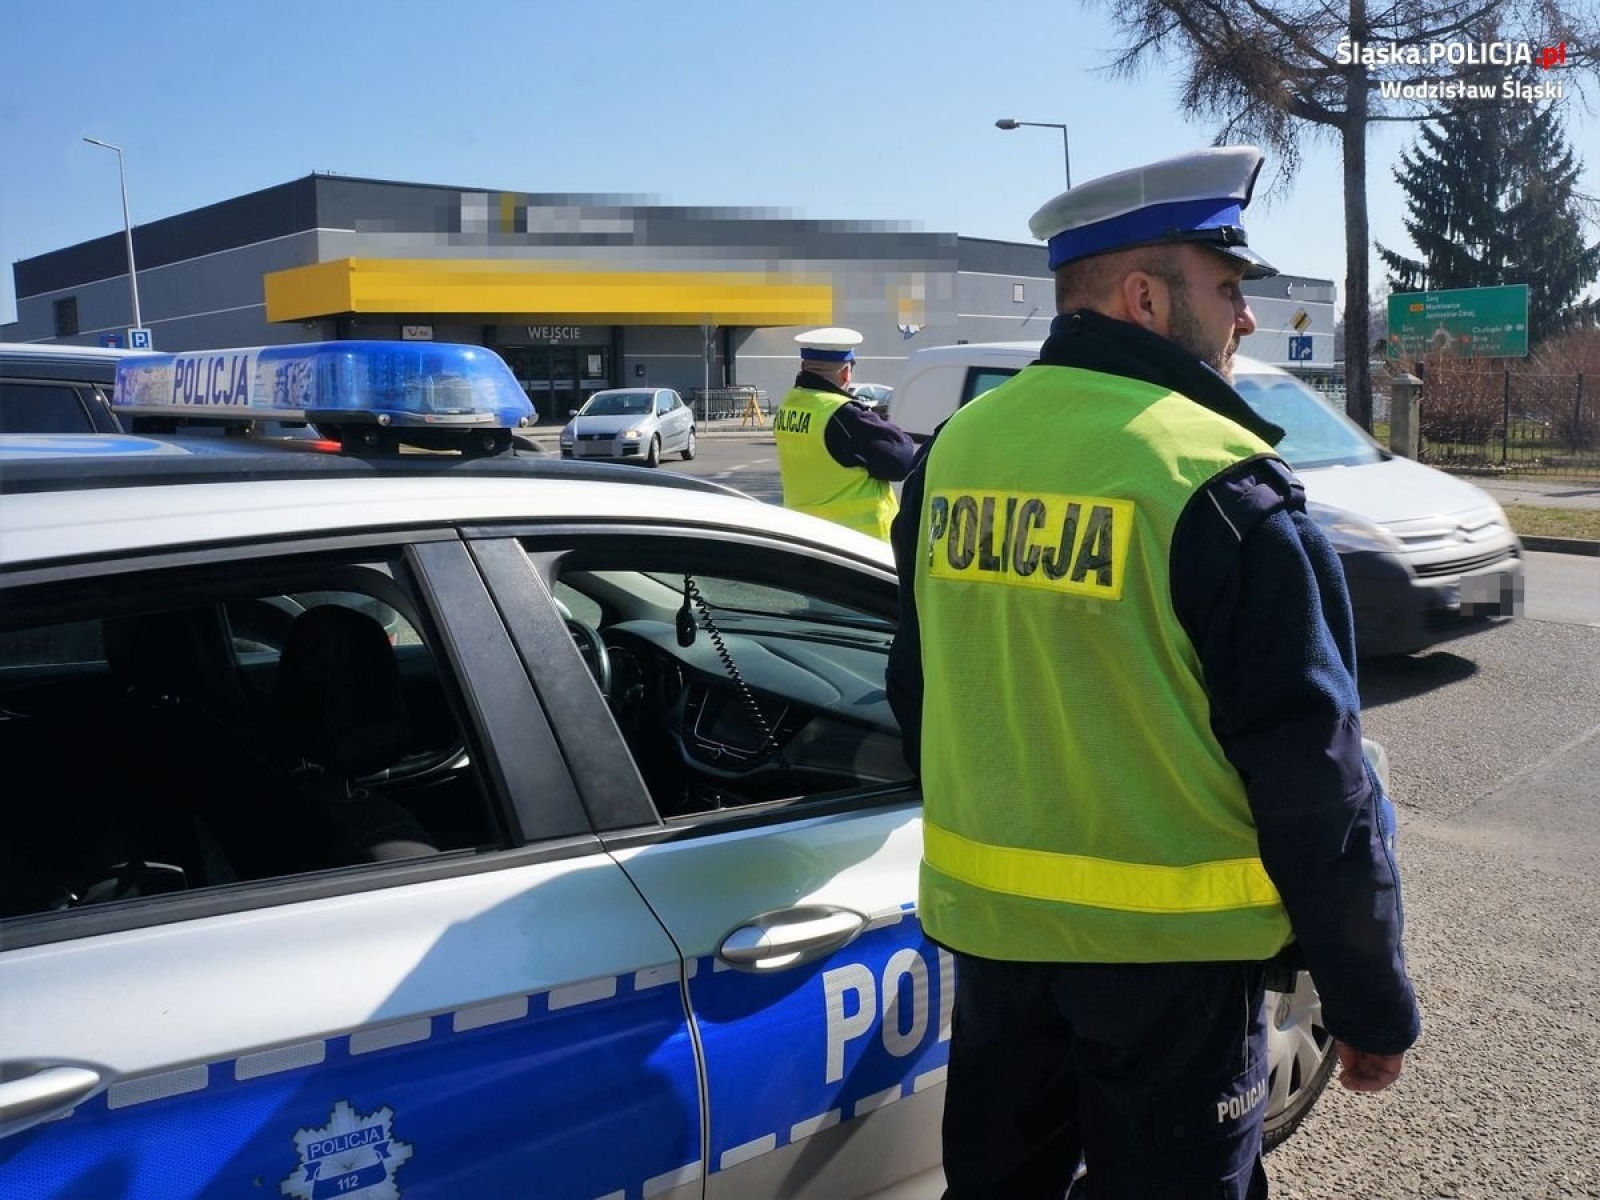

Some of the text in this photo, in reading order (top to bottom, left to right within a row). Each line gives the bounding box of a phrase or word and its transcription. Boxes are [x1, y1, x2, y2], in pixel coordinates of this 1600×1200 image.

[135, 332, 146, 346] P
[172, 355, 249, 405] POLICJA
[929, 495, 1113, 587] POLICJA
[310, 1128, 381, 1158] POLICJA
[337, 1175, 359, 1191] 112
